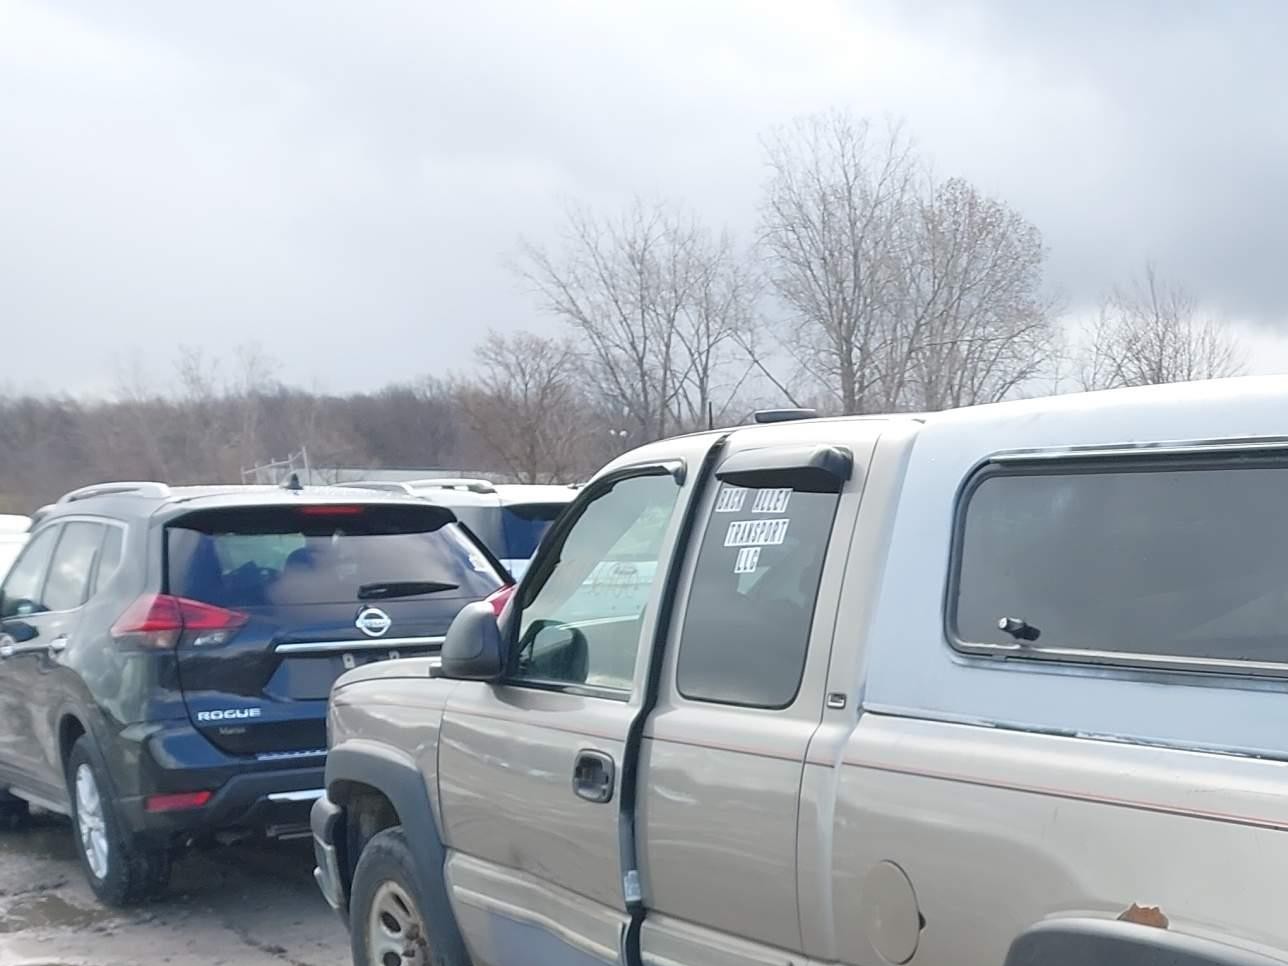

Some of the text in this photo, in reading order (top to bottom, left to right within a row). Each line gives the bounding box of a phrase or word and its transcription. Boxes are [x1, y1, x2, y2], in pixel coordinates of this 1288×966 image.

[725, 519, 789, 546] TRANSPORT
[736, 548, 760, 572] LLC
[197, 707, 261, 721] ROGUE
